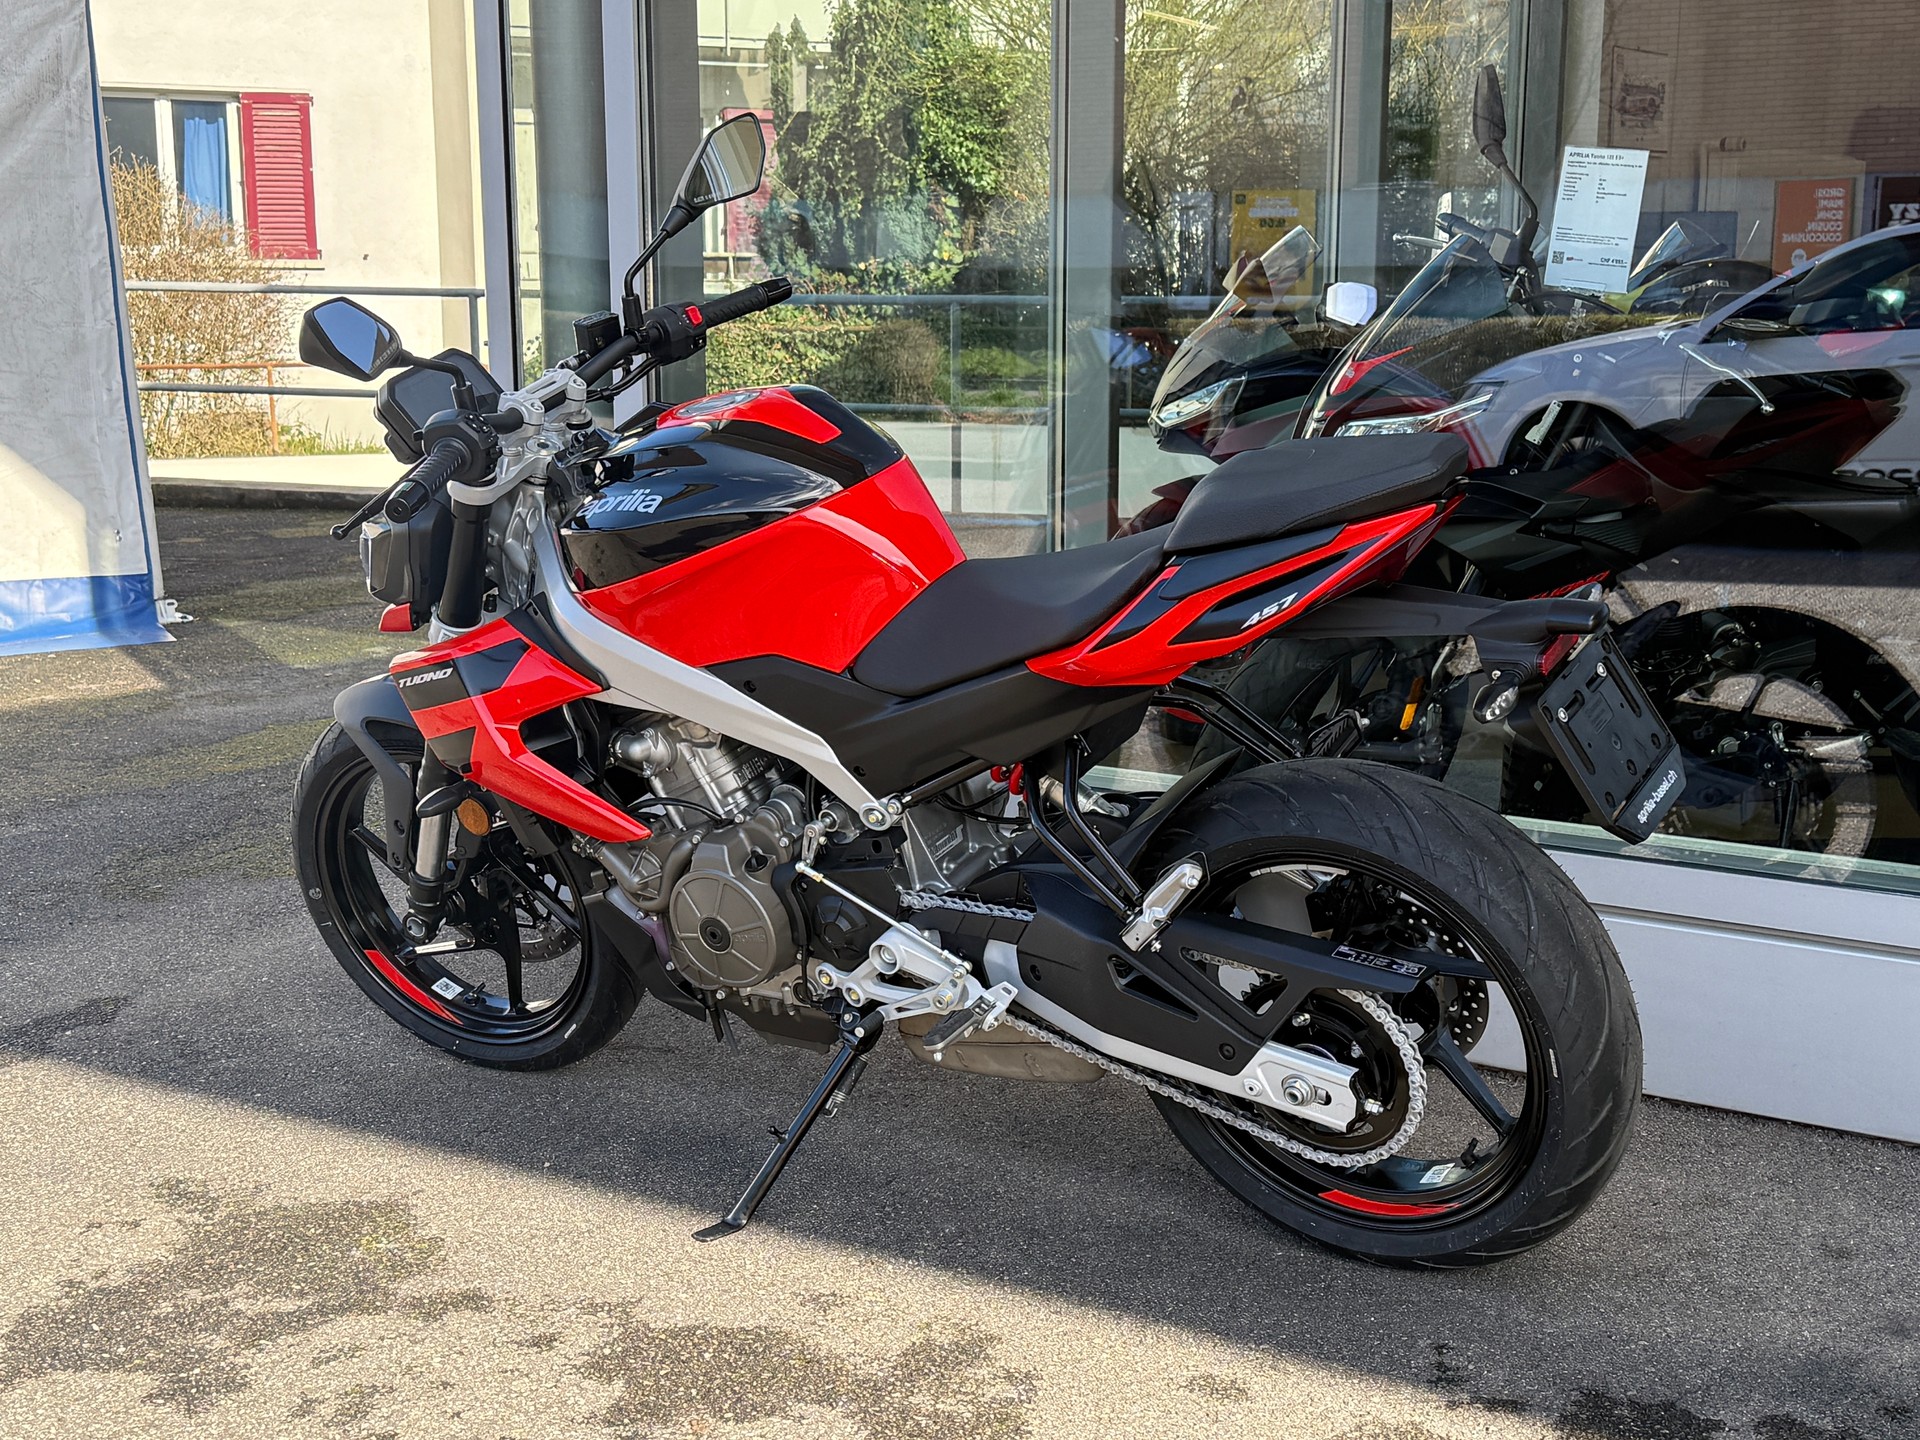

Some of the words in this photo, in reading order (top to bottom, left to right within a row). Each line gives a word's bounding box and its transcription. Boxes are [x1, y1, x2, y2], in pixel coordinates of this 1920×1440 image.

[1681, 279, 1730, 293] aprlia
[576, 489, 663, 519] aprilia
[1240, 592, 1298, 629] 457
[398, 667, 454, 688] TUONO
